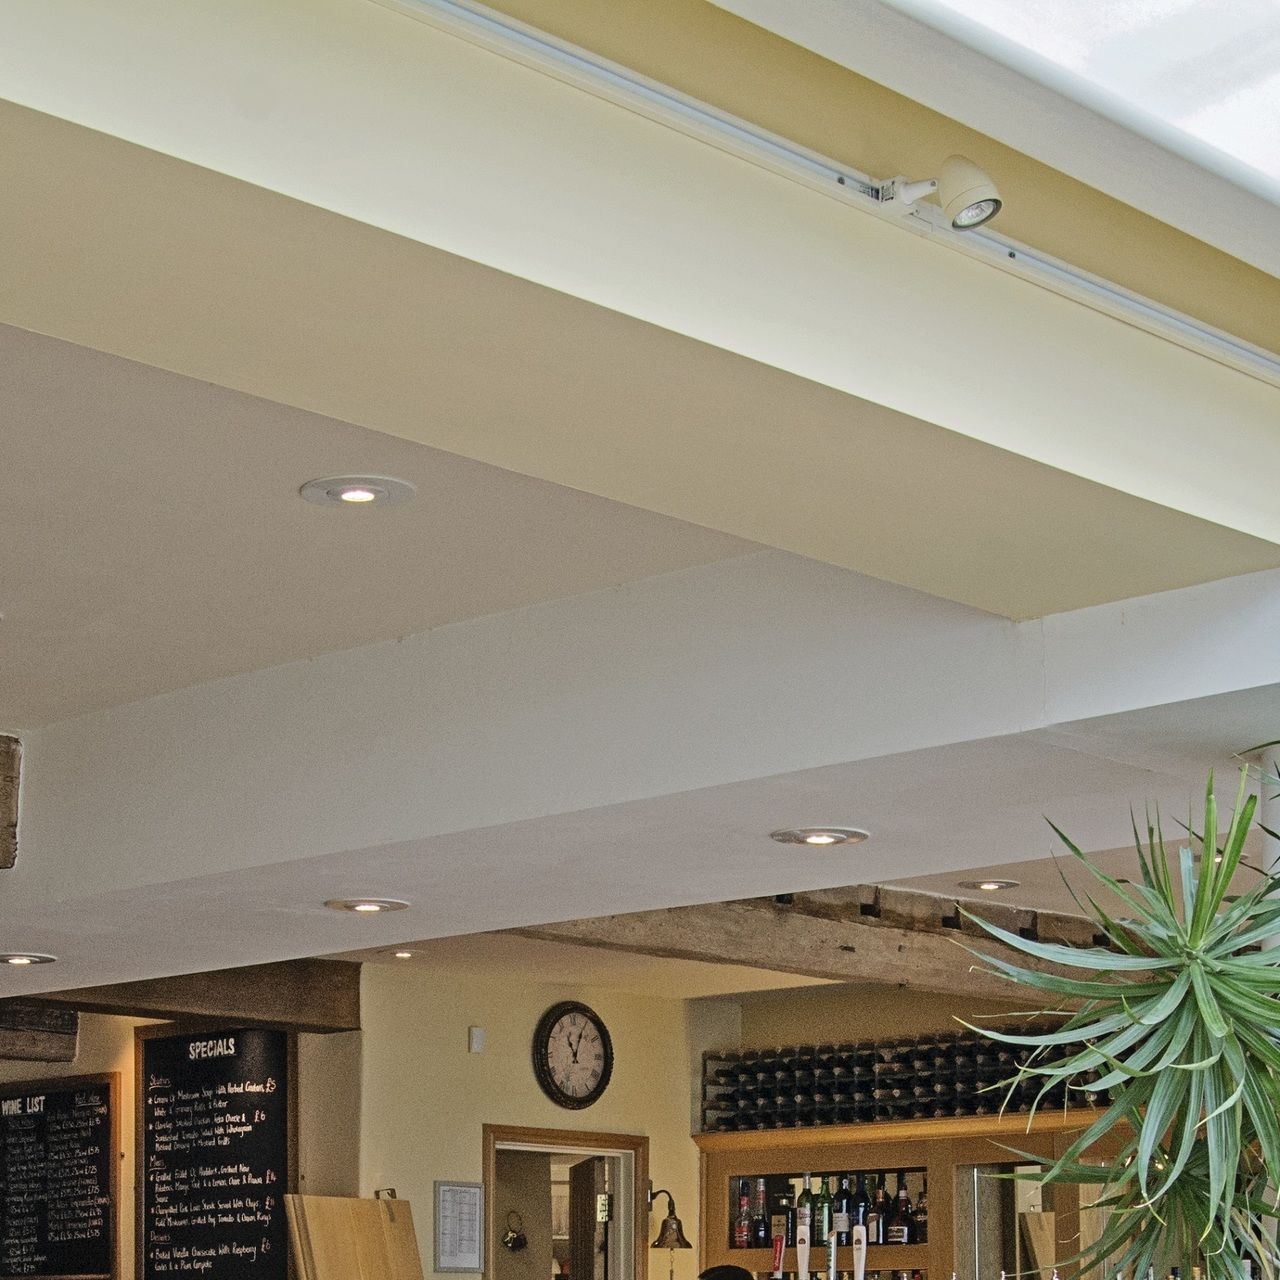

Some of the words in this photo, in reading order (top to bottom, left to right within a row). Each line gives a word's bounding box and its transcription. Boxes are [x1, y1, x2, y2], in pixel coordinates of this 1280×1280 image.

[189, 1038, 235, 1060] SPECIALS
[266, 1078, 276, 1093] £5
[2, 1099, 22, 1115] WINE
[26, 1096, 45, 1113] LIST
[255, 1110, 266, 1122] £6
[262, 1237, 270, 1253] £6
